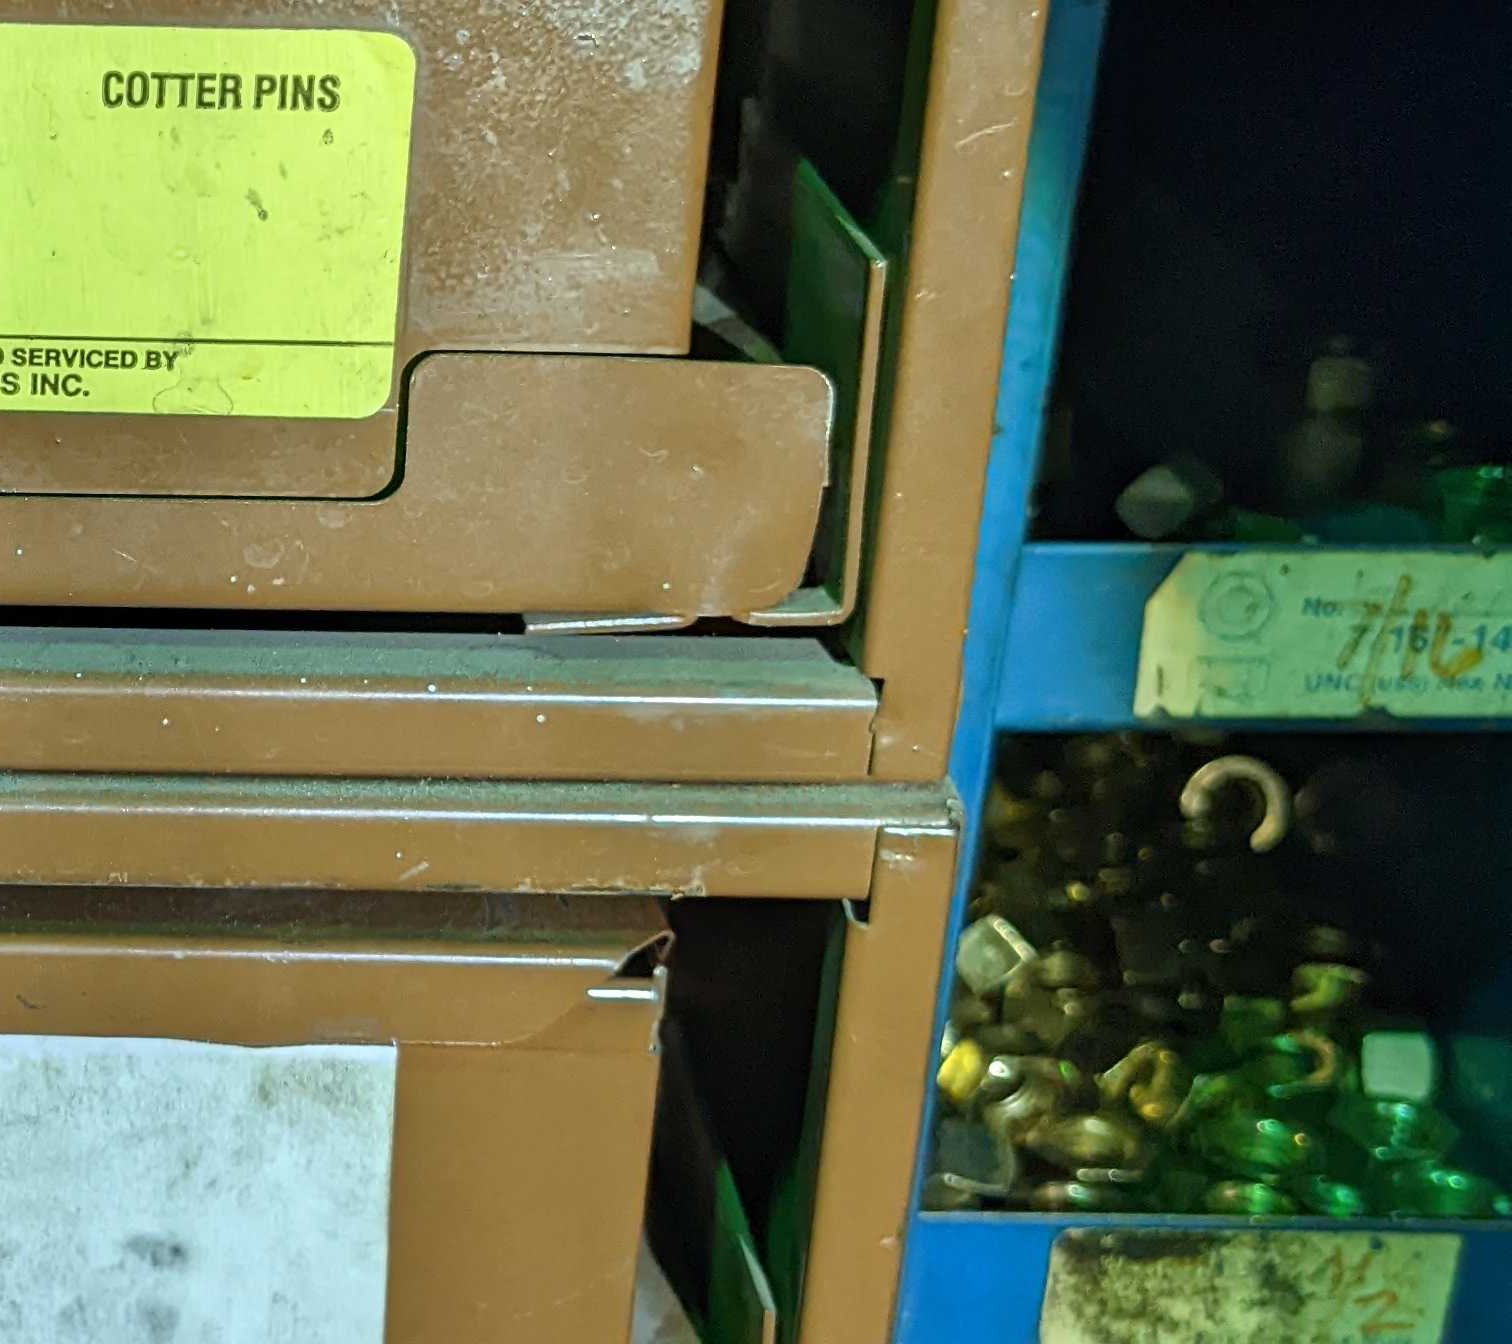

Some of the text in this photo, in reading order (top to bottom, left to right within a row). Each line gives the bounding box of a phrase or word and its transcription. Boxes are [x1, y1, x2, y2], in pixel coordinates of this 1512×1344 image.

[102, 70, 341, 113] COTTER PINS
[11, 347, 138, 369] SERVICED
[142, 350, 179, 371] BY
[30, 373, 90, 397] INC.
